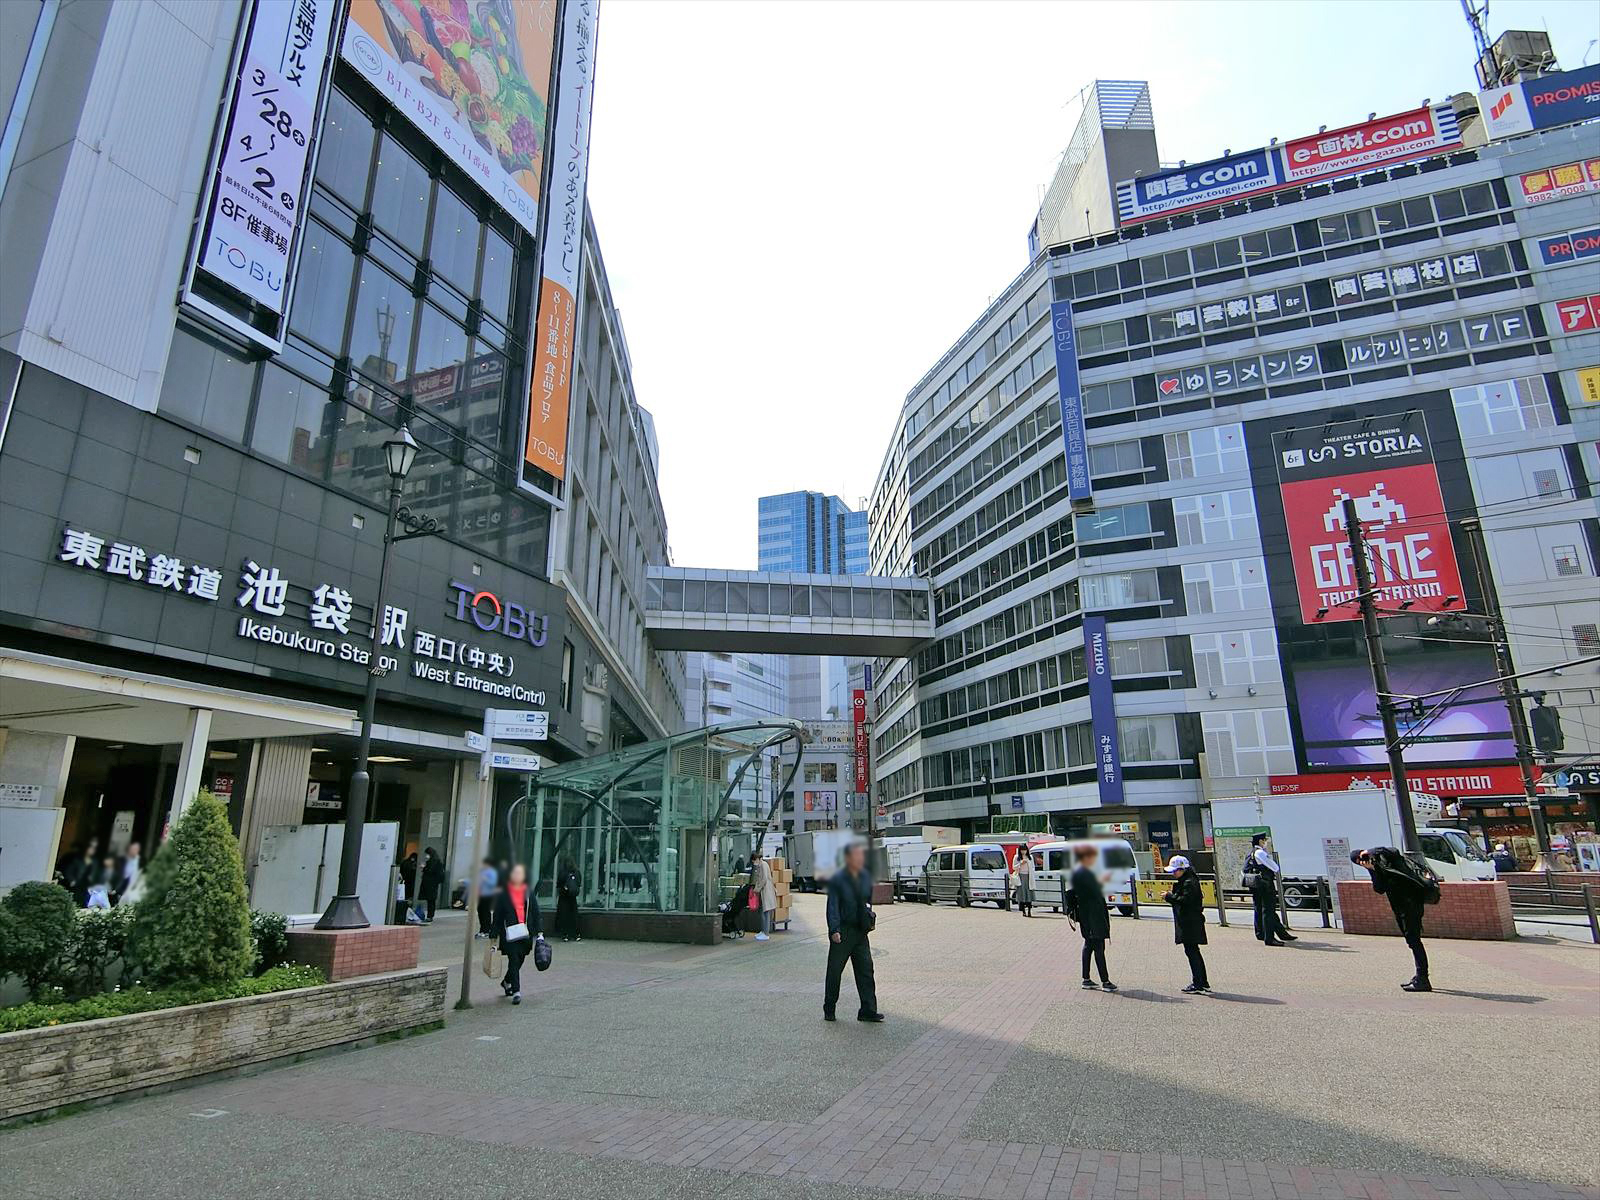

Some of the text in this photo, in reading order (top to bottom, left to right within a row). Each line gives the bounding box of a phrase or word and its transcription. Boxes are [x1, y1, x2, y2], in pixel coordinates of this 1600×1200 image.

[285, 0, 317, 87] 当地グルメ
[1291, 139, 1436, 177] http://www.e-gazai.com
[1293, 120, 1427, 162] e-画材.com
[502, 181, 535, 220] TOBU
[1142, 179, 1267, 213] http://www.tougei.com
[215, 236, 281, 291] TOBU
[1285, 298, 1300, 307] 8F
[1055, 308, 1072, 352] TOBU
[1064, 397, 1083, 452] 東武百貨店
[1323, 435, 1352, 444] THEATER
[1377, 427, 1400, 436] DINING
[1343, 434, 1422, 457] STORIA
[532, 437, 563, 465] TOBU
[1287, 454, 1299, 464] 6F
[60, 527, 222, 601] 東武鉄道
[1309, 533, 1438, 589] GAME
[237, 560, 409, 649] 池袋駅
[450, 578, 549, 648] TOBU
[240, 617, 399, 672] Ikebukuro Staon
[1092, 633, 1105, 675] MIZUHO
[415, 661, 547, 707] West Entrance(Cntrl)
[1100, 735, 1115, 783] みずほ銀行
[1379, 775, 1492, 791] TATO STATION
